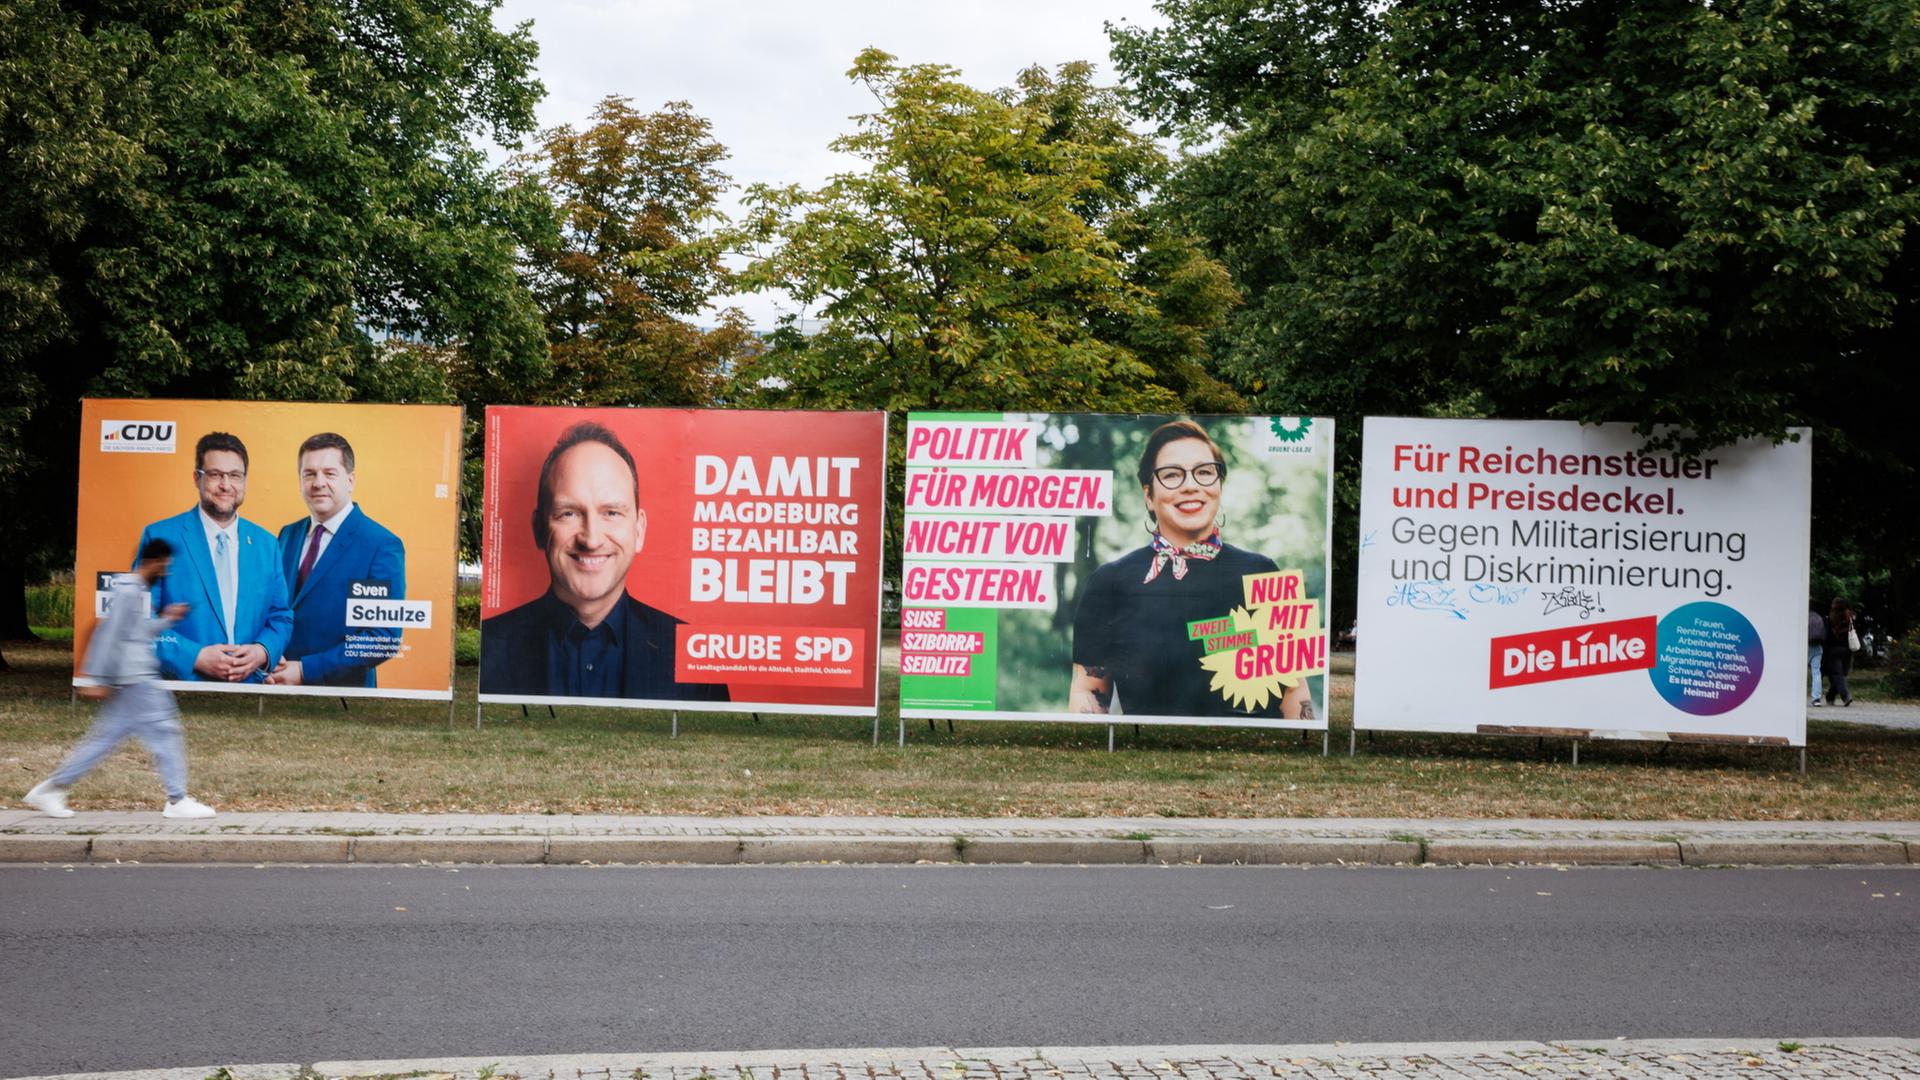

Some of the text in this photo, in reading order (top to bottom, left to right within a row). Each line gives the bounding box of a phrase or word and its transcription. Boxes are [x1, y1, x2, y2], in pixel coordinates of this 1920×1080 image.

[121, 424, 172, 441] CDU
[908, 427, 1030, 460] POLITIK
[1394, 444, 1718, 480] Für Reichensteuer
[694, 455, 860, 497] DAMIT
[906, 466, 1105, 510] FÜR MORGEN.
[1393, 483, 1684, 515] und Preisdeckel.
[693, 501, 858, 525] MAGDEBURG
[692, 528, 858, 554] BEZAHLBAR
[905, 521, 1068, 556] NICHT VON
[1392, 517, 1746, 562] Gegen Militarisierung
[690, 558, 856, 605] BLEIBT
[905, 567, 1046, 603] GESTERN.
[1391, 554, 1450, 582] und
[1464, 554, 1732, 597] Diskriminierung.
[352, 582, 388, 596] Sven
[1251, 576, 1299, 604] NUR
[352, 605, 426, 622] Schulze
[904, 610, 944, 628] SUSE
[1268, 604, 1313, 630] MIT
[1694, 618, 1725, 630] Frauen,
[1192, 620, 1232, 638] ZWEIT-
[1676, 626, 1741, 642] Rentner, Kinder,
[686, 634, 853, 662] GRUBE SPD
[903, 633, 981, 652] SZIBORRA-
[1207, 632, 1254, 652] STIMME
[1504, 630, 1646, 676] Die Linke
[1678, 637, 1737, 652] Arbeitnehmer,
[902, 656, 968, 674] SEIDLITZ
[1235, 634, 1325, 680] GRÜN!
[1660, 654, 1751, 674] Migrantinnen, Lesben,
[1666, 646, 1748, 663] Arbeitslose, Kranke,
[696, 664, 748, 672] Landtagskandidat
[1668, 666, 1740, 682] Schwule, Queere:
[1668, 675, 1736, 691] Es ist auch Eure
[1684, 687, 1719, 699] Heimat!
